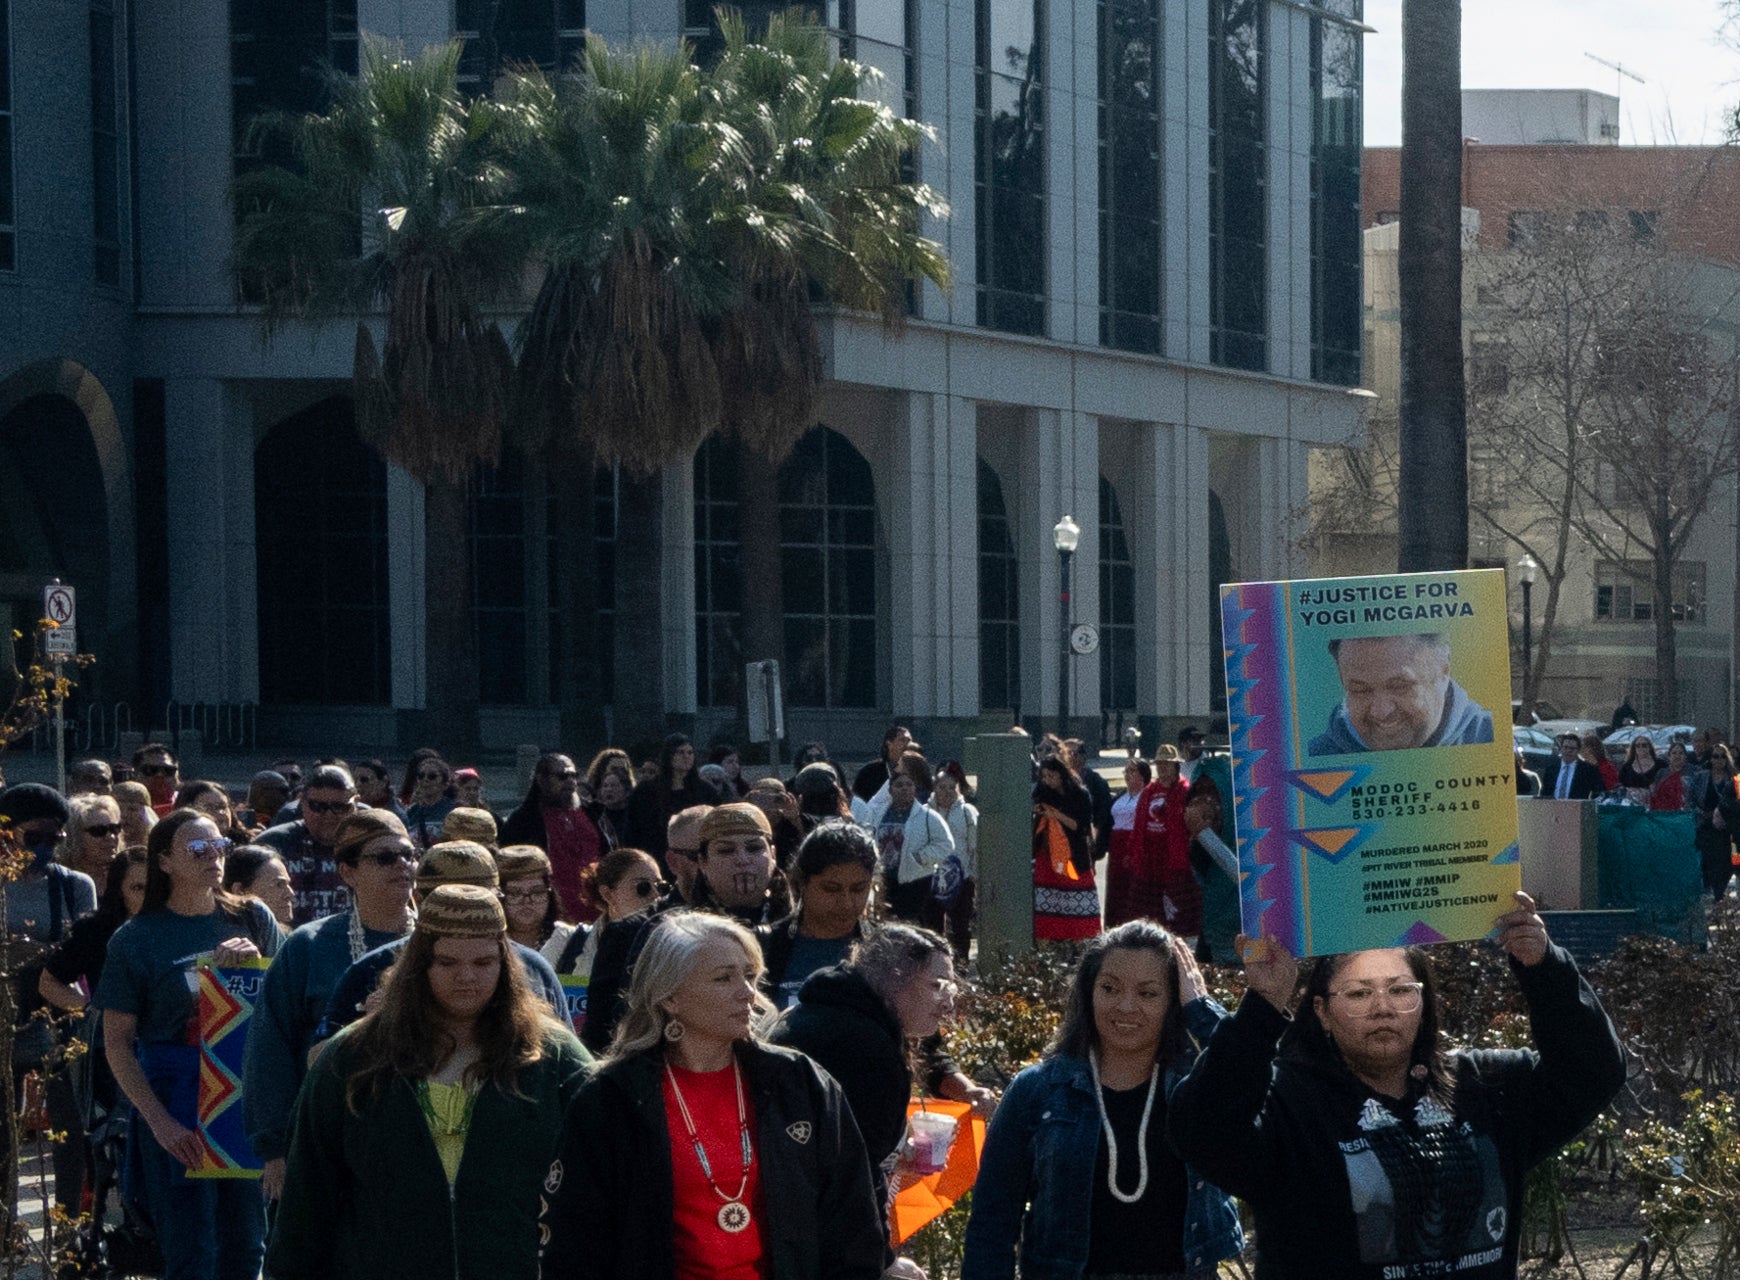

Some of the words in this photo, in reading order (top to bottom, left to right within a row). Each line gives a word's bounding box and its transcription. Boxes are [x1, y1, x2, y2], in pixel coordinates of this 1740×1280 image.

[1299, 585, 1407, 605] #JUSTICE
[1415, 582, 1459, 598] FOR
[1300, 610, 1356, 626] YOGI
[1364, 602, 1474, 623] MCGARVA
[1351, 782, 1418, 798] MODOC
[1435, 774, 1511, 790] COUNTY
[1352, 792, 1432, 809] SHERIFF
[1352, 800, 1481, 820] 530-233-4416
[1361, 846, 1420, 859] MURDERED
[1422, 842, 1461, 853] MARCH
[1463, 840, 1489, 850] 2020
[1384, 861, 1411, 871] RIVER
[1413, 858, 1447, 868] TRIBAL
[1448, 854, 1489, 864] MEMBER
[1362, 878, 1412, 892] #MMIW
[1416, 873, 1461, 887] #MMIP
[1365, 893, 1499, 915] #NATIVEJUSTICENOW
